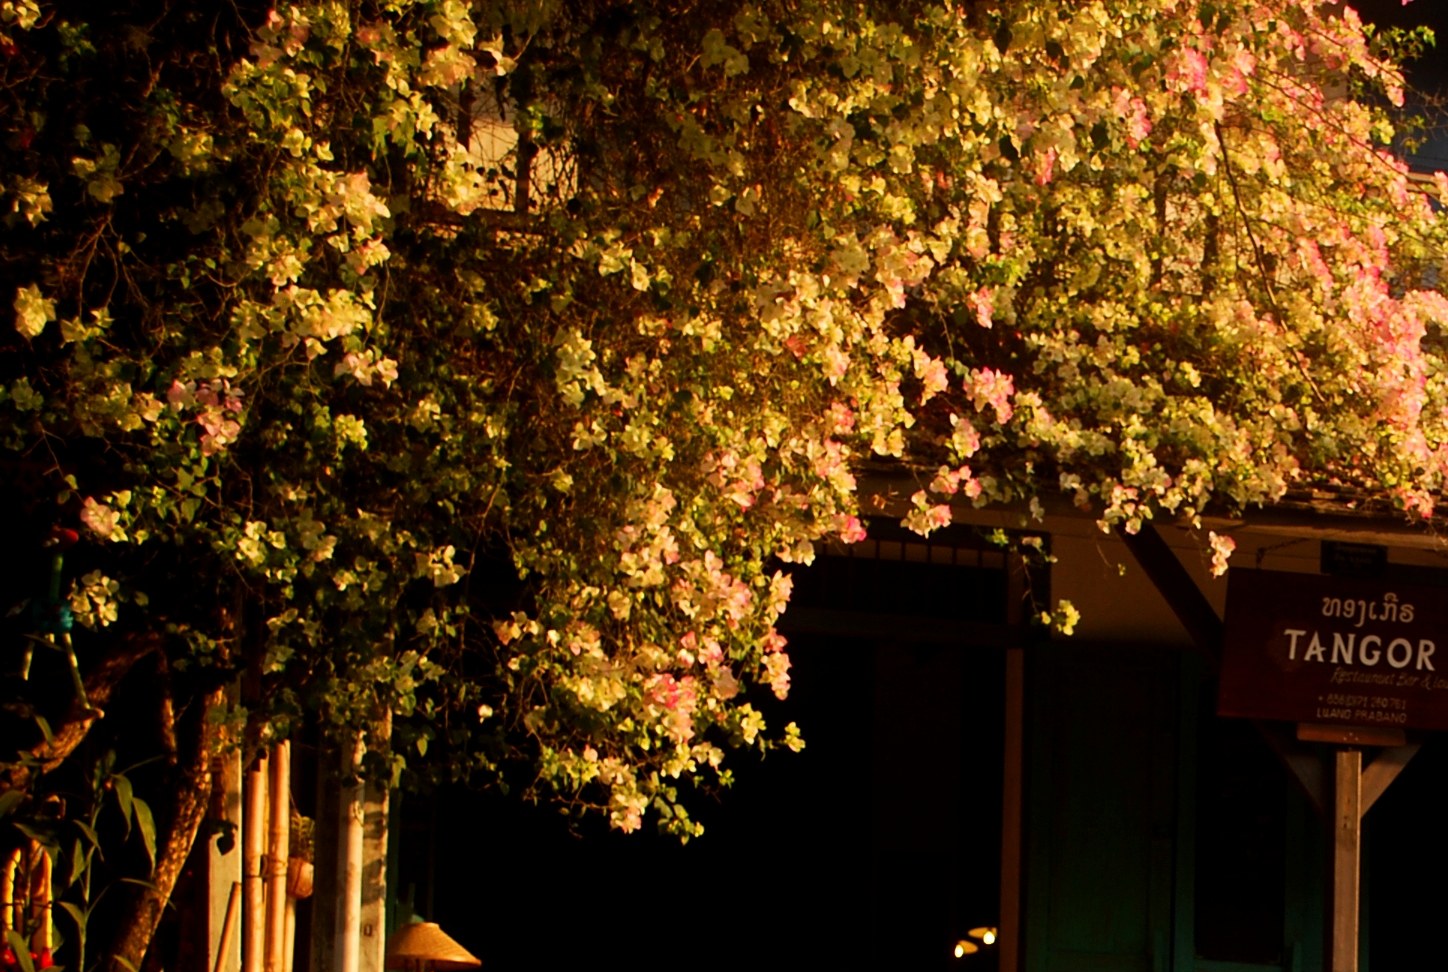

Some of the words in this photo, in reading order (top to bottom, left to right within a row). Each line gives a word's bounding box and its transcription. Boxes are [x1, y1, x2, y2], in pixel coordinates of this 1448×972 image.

[1283, 628, 1436, 671] TANGOR
[1330, 666, 1395, 685] Restaurant
[1316, 707, 1352, 720] LUANG
[1354, 709, 1408, 724] PRABANG
